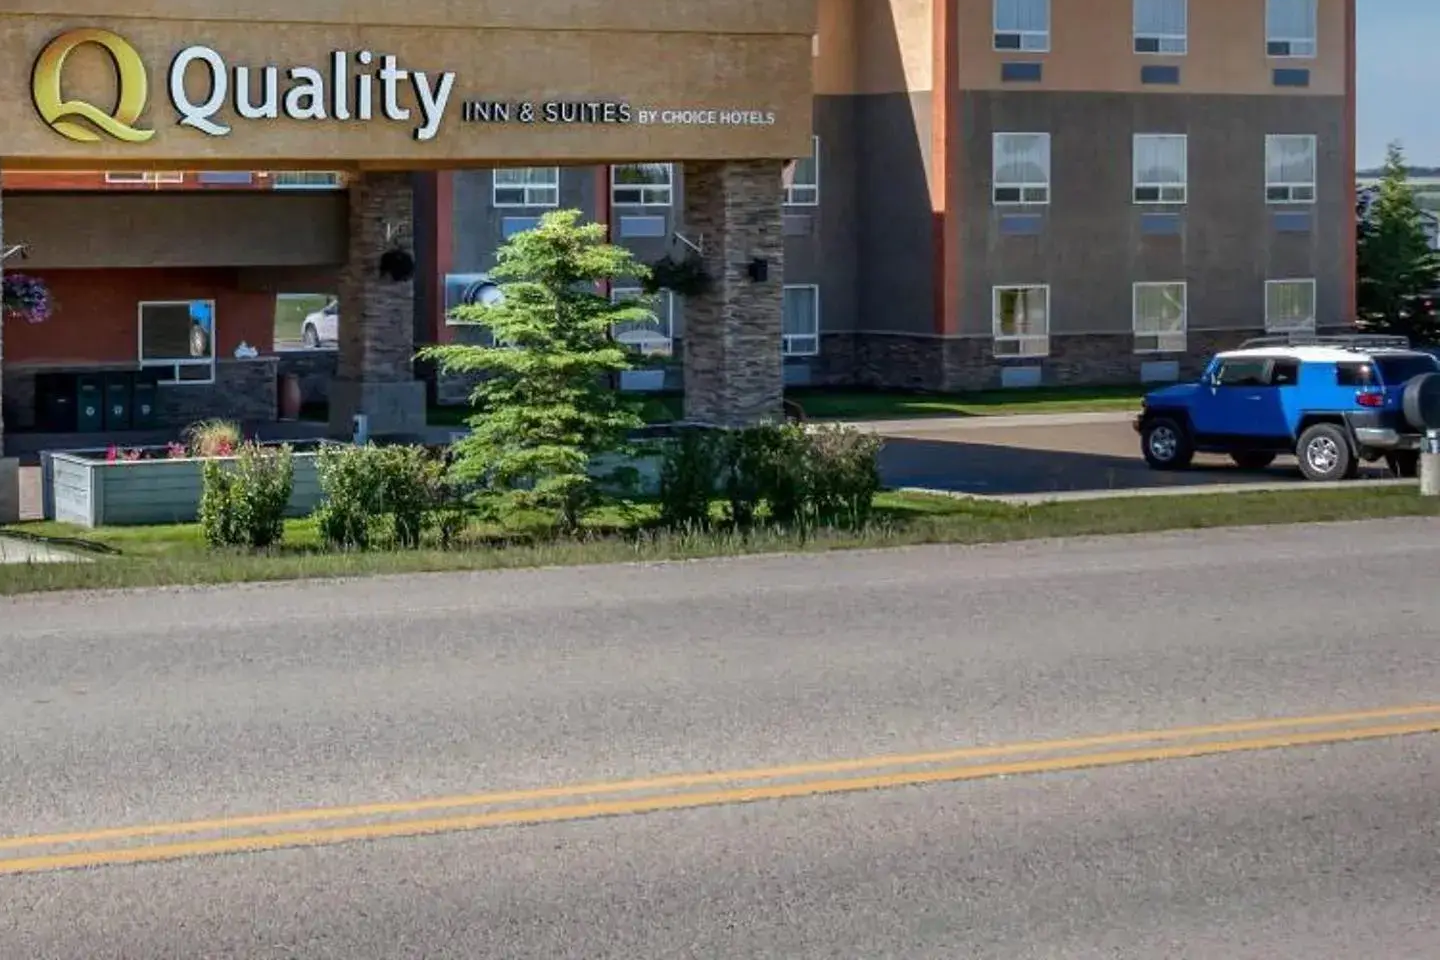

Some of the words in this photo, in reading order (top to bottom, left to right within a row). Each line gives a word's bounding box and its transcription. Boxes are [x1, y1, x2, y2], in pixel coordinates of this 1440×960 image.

[32, 27, 155, 141] Q
[169, 44, 456, 140] Quality
[464, 102, 510, 122] INN
[519, 102, 535, 123] &
[545, 102, 632, 123] SUITES
[638, 110, 658, 124] BY
[661, 110, 717, 124] CHOICE
[719, 111, 776, 126] HOTELS
